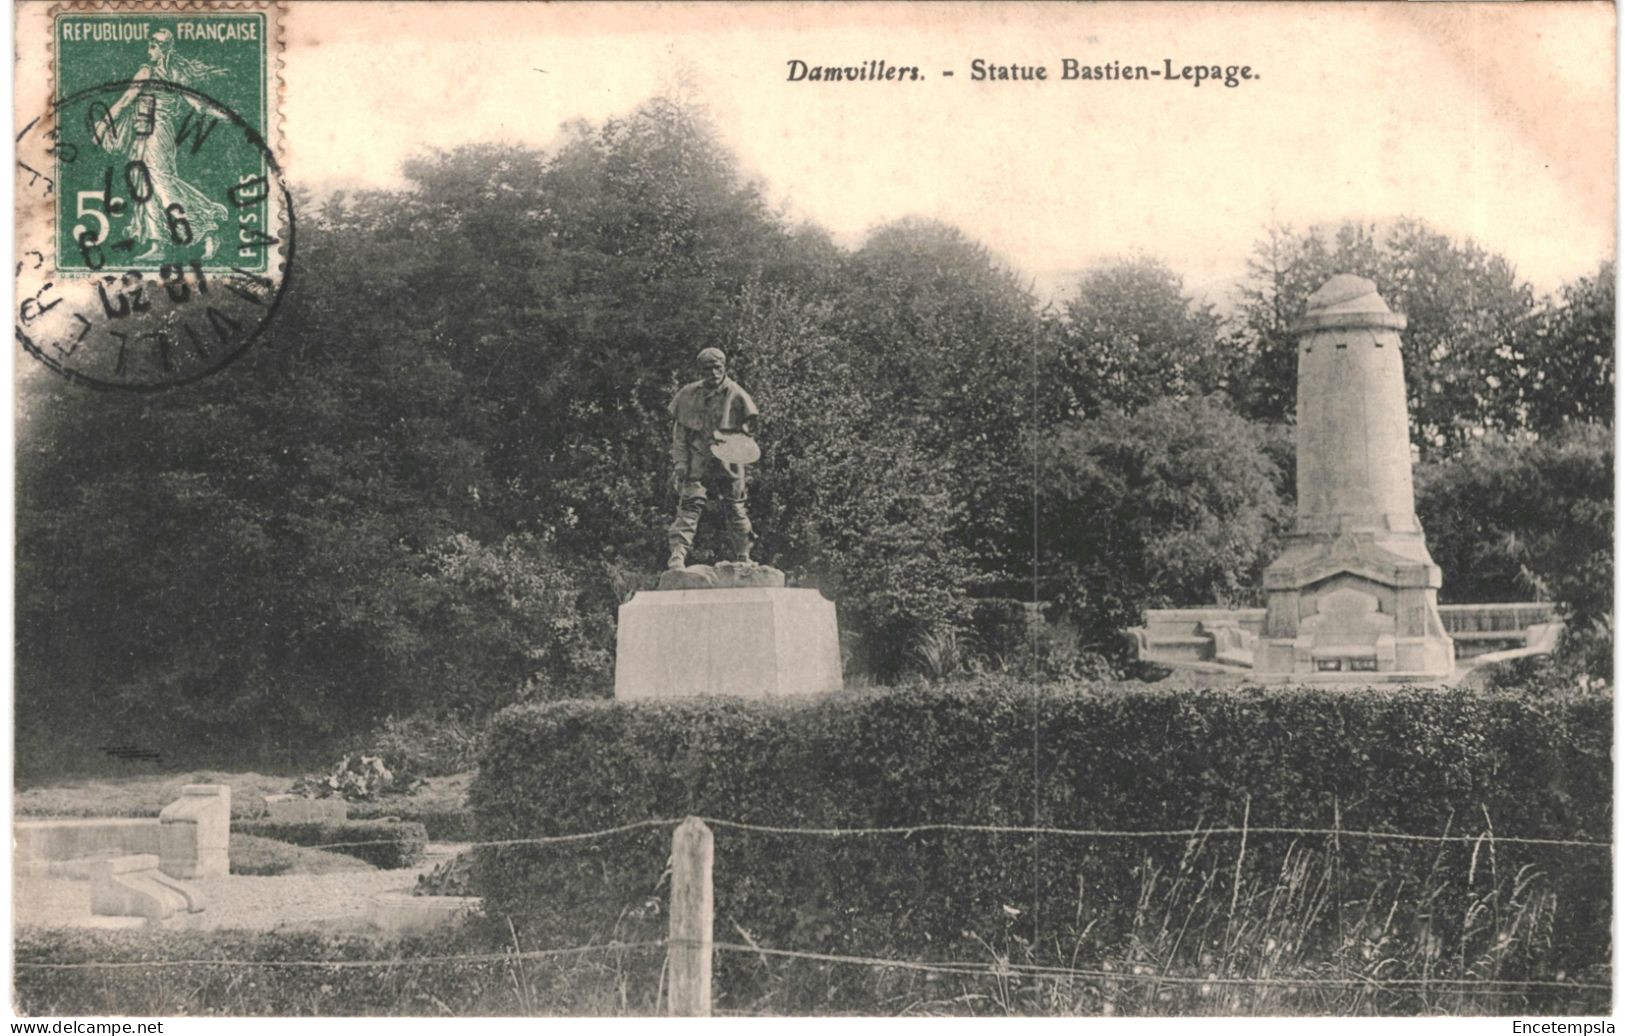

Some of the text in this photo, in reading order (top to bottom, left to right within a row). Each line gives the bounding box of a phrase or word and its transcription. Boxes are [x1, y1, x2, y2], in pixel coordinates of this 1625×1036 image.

[177, 24, 258, 43] FRANÇAISE
[786, 59, 925, 81] Damvillers.
[970, 58, 1048, 81] Statue
[1061, 58, 1261, 87] Bastien-Lepage.
[240, 173, 258, 258] POSTES
